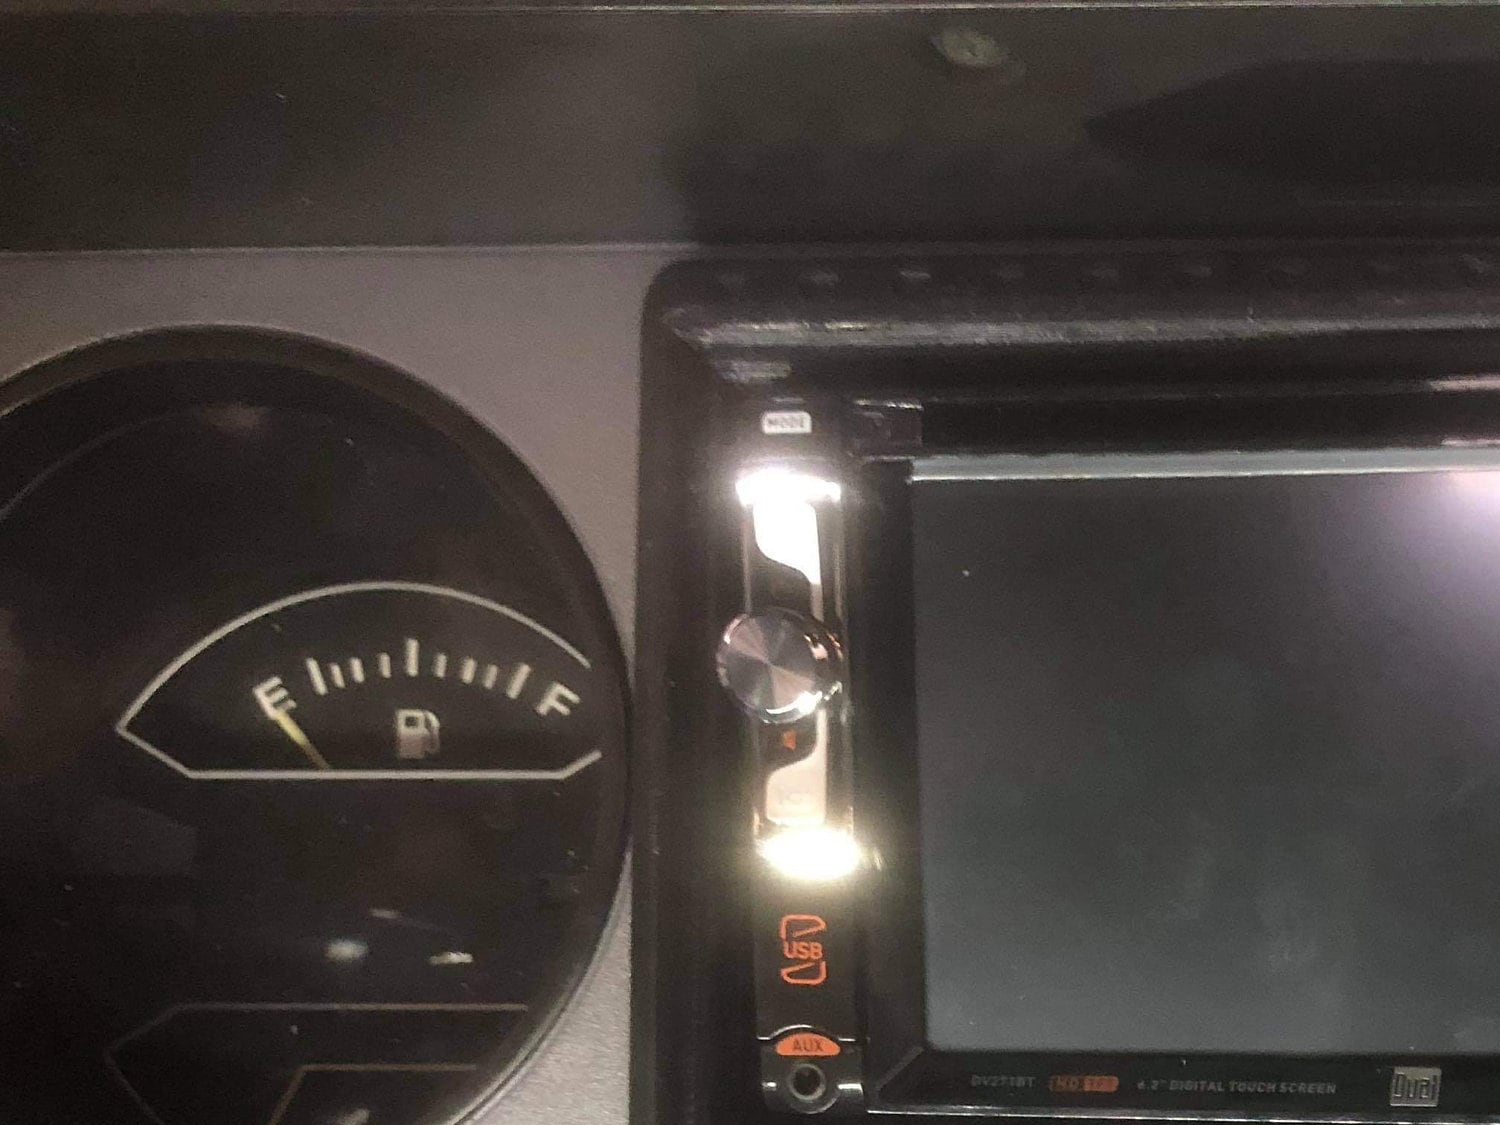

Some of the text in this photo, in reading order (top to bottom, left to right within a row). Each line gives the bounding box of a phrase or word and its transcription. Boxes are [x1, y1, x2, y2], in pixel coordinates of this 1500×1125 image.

[536, 681, 581, 717] F
[783, 941, 823, 959] USB
[792, 1038, 824, 1052] AUX
[1169, 1080, 1224, 1092] DIGITAL
[1229, 1081, 1277, 1093] TOUCH
[1280, 1082, 1337, 1095] SCREEN
